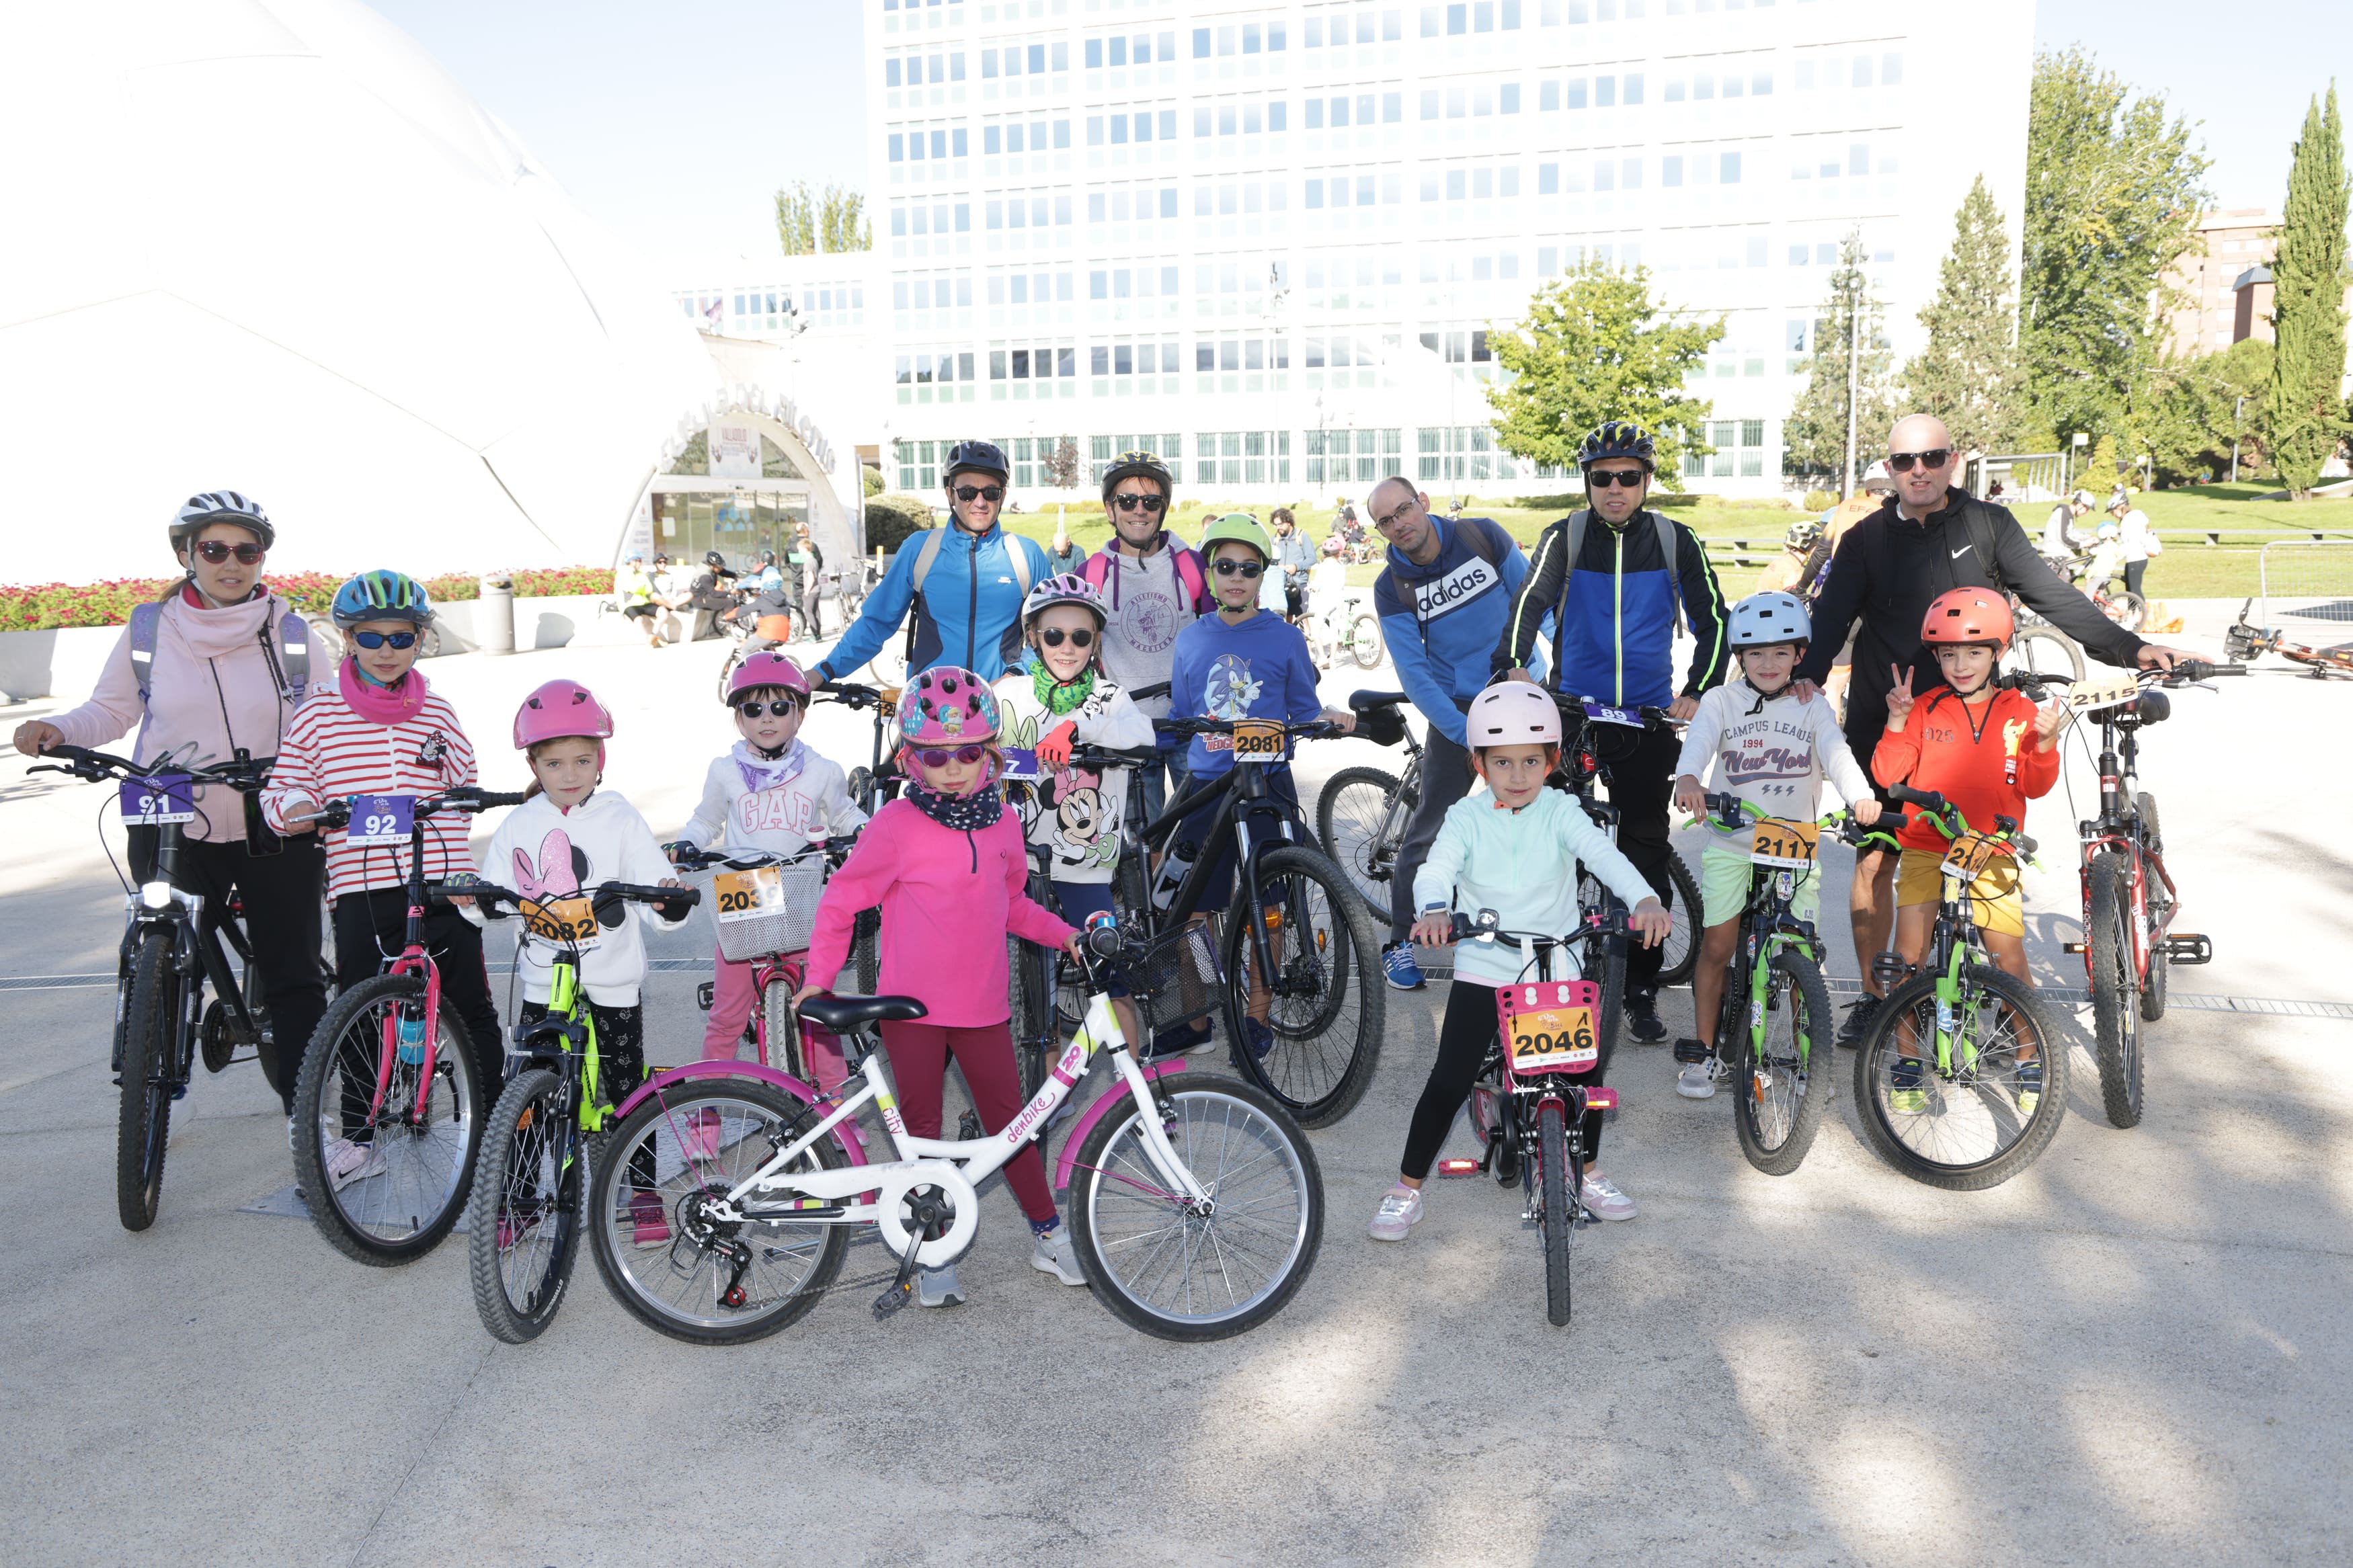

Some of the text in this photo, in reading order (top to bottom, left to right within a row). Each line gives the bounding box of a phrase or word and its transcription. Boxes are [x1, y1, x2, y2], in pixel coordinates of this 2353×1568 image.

[1130, 593, 1168, 606] ATLETISMO
[1418, 568, 1487, 613] adidas
[2074, 688, 2136, 706] 2115
[1601, 708, 1628, 721] 89
[1724, 720, 1769, 740] CAMPUS
[1925, 727, 1954, 742] 025
[1237, 736, 1283, 753] 2081
[1743, 739, 1763, 748] 1994
[1721, 746, 1812, 773] New York
[138, 794, 169, 815] 91
[738, 788, 814, 836] GAP
[365, 815, 397, 835] 92
[1755, 837, 1816, 858] 2117
[721, 886, 779, 912] 2039
[528, 919, 597, 940] 2082
[1515, 1028, 1593, 1057] 2046
[1062, 1045, 1081, 1072] 20
[882, 1108, 902, 1134] city
[1008, 1092, 1055, 1143] denbike
